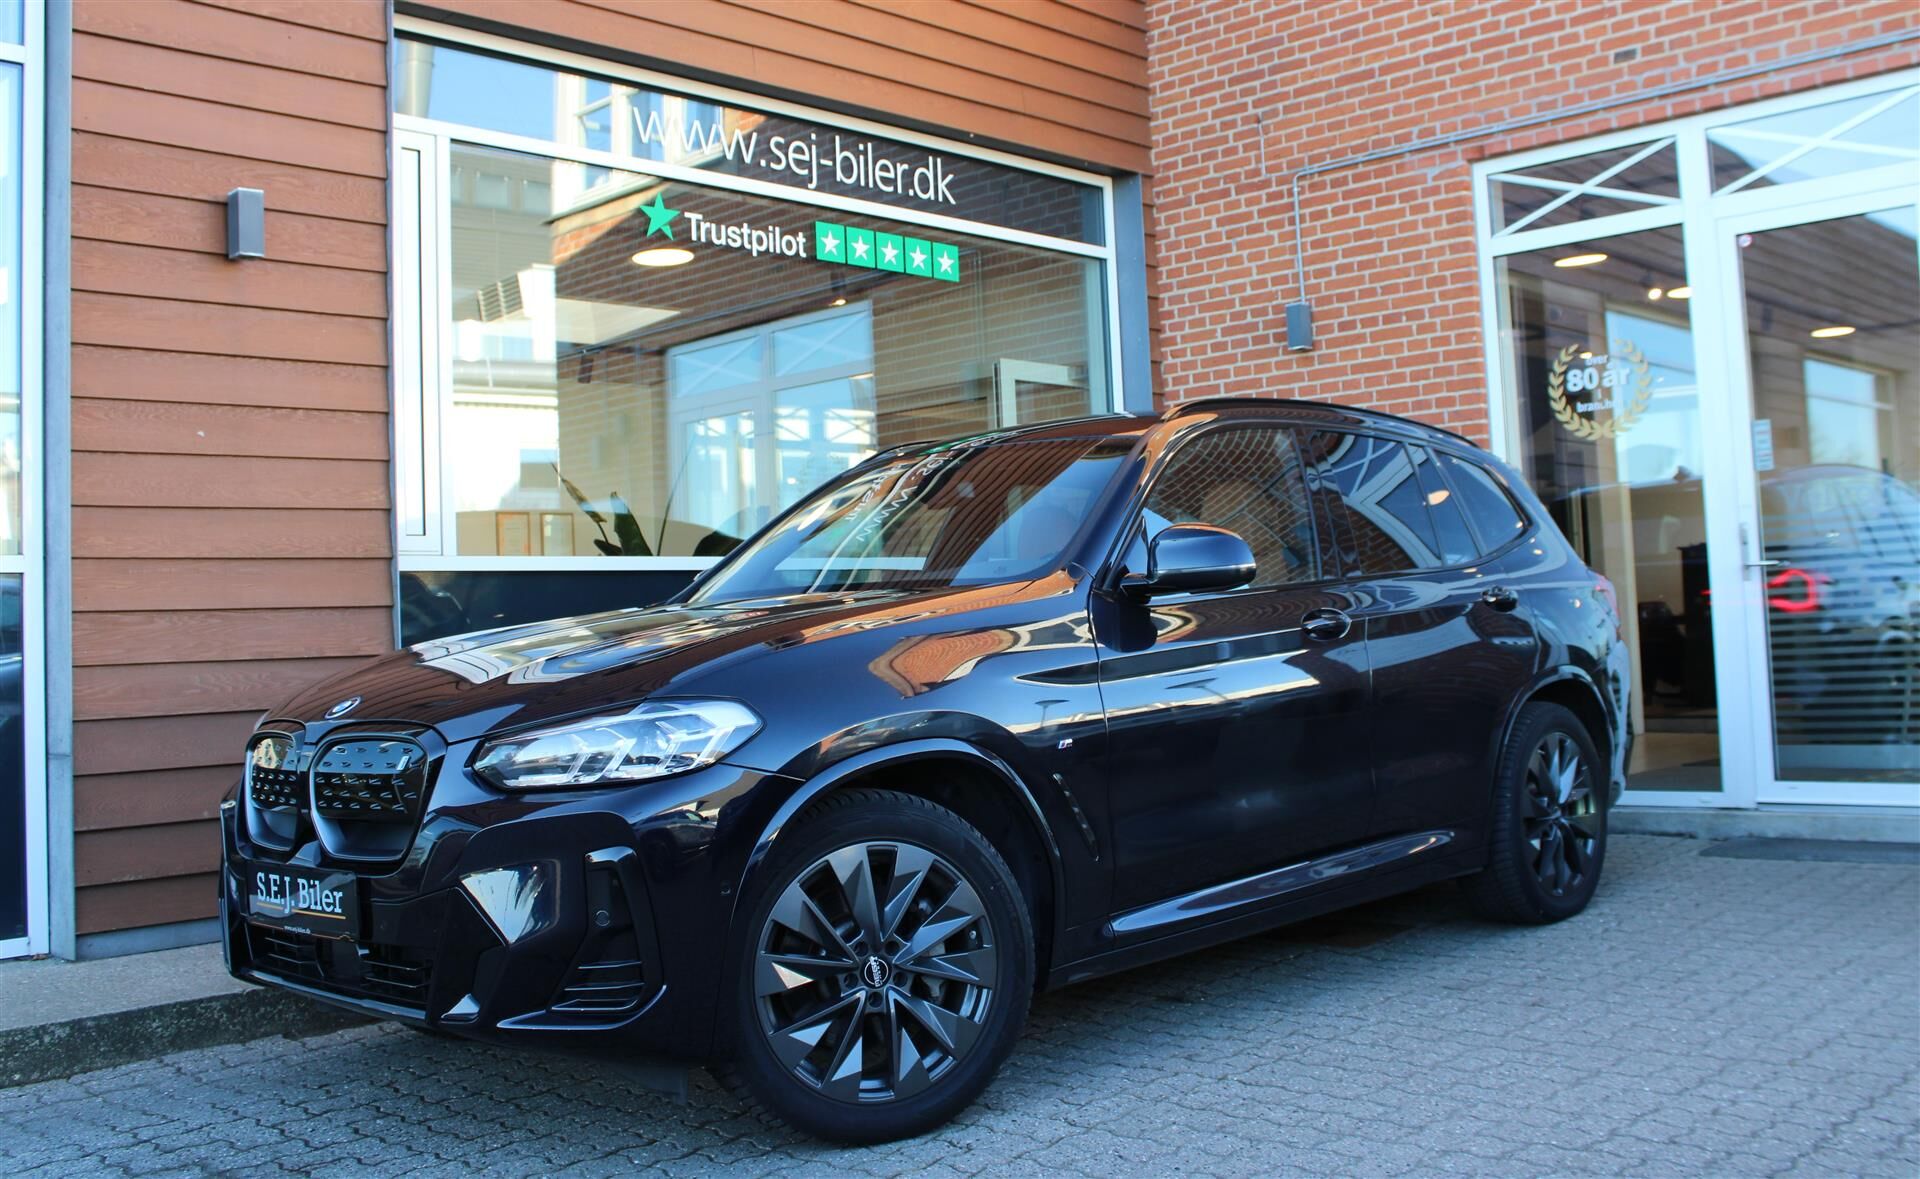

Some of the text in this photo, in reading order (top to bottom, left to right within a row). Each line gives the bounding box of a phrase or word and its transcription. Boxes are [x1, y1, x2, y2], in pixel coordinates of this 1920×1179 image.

[633, 106, 957, 205] www.sej-biler.dk
[684, 211, 807, 258] Trustpilot
[1566, 361, 1630, 392] 80 år
[256, 871, 343, 914] S.E.J. Biler
